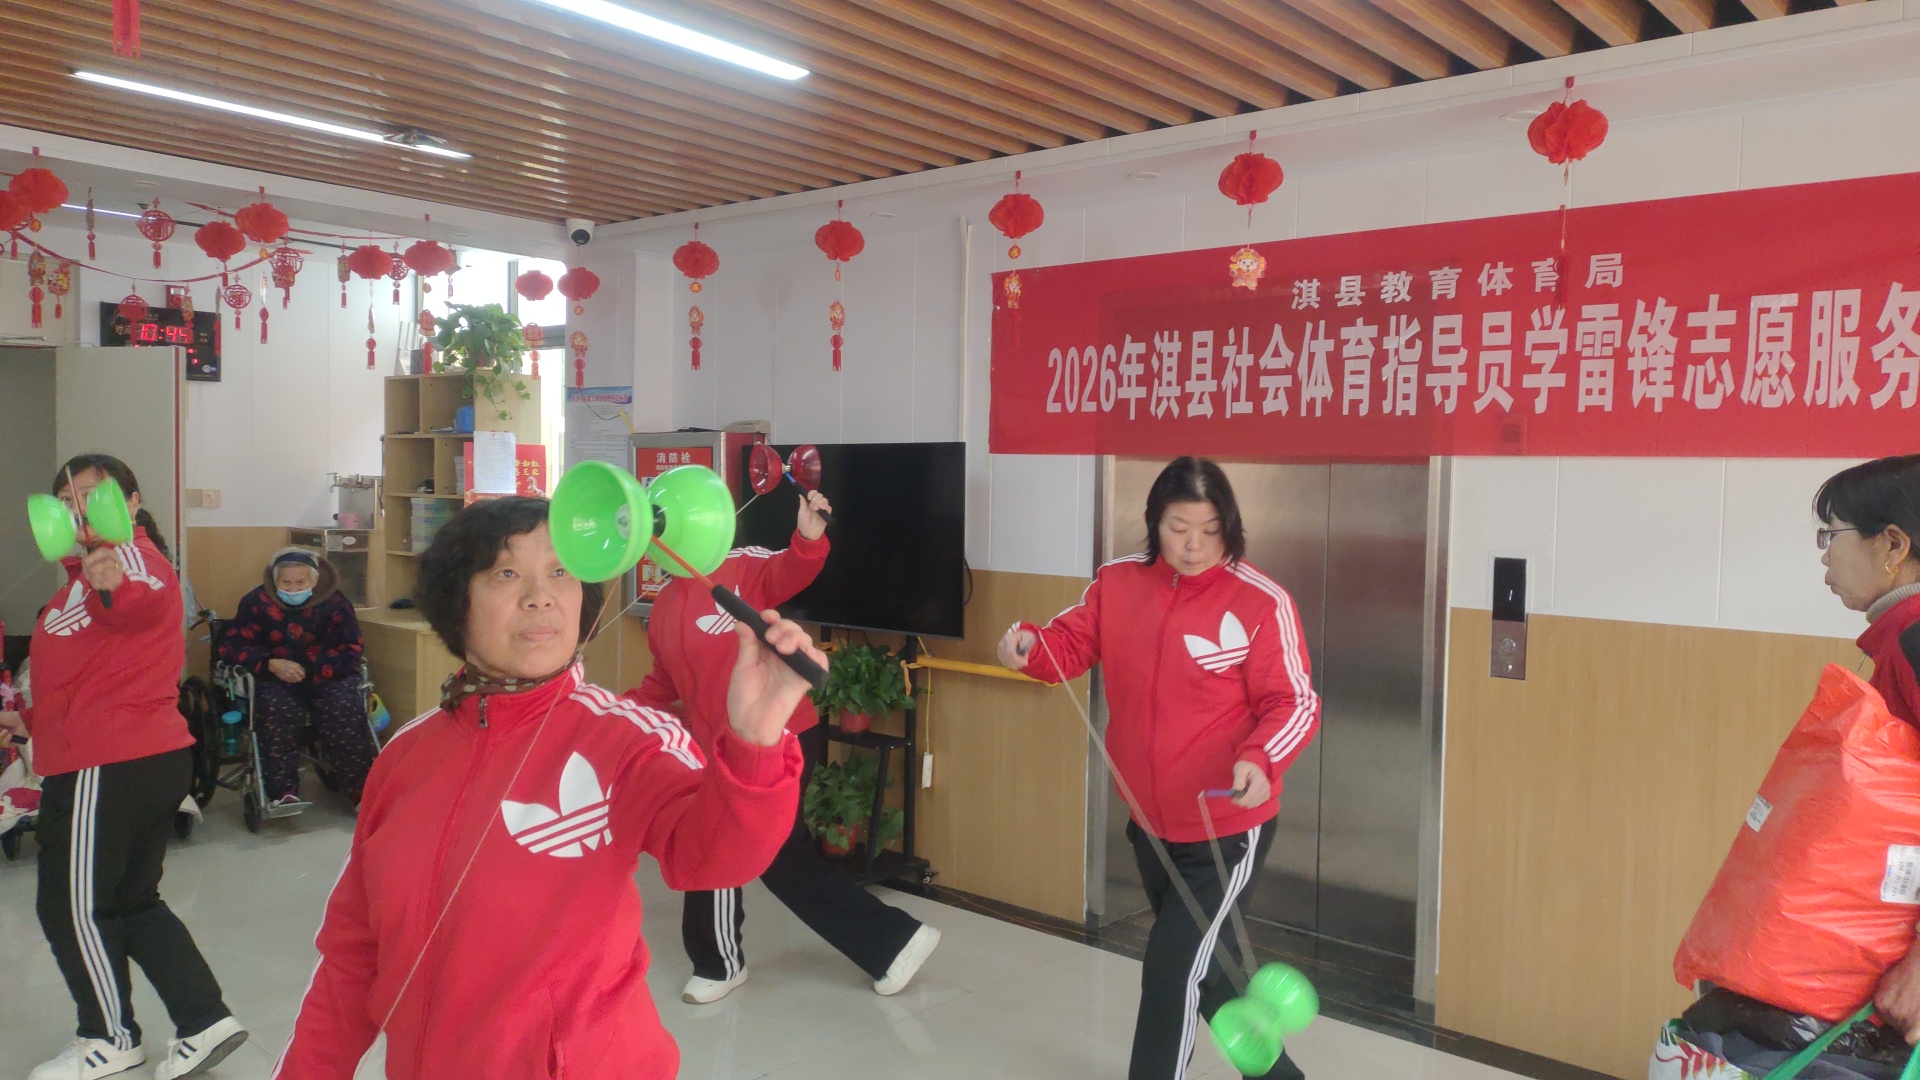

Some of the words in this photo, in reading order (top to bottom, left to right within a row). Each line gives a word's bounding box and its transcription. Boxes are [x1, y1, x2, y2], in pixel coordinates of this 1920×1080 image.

[1290, 252, 1625, 311] 淇县教育体育局
[1046, 281, 1920, 421] 2026年淇县社会体育指导员学雷锋志愿服务
[656, 451, 692, 464] 消防栓
